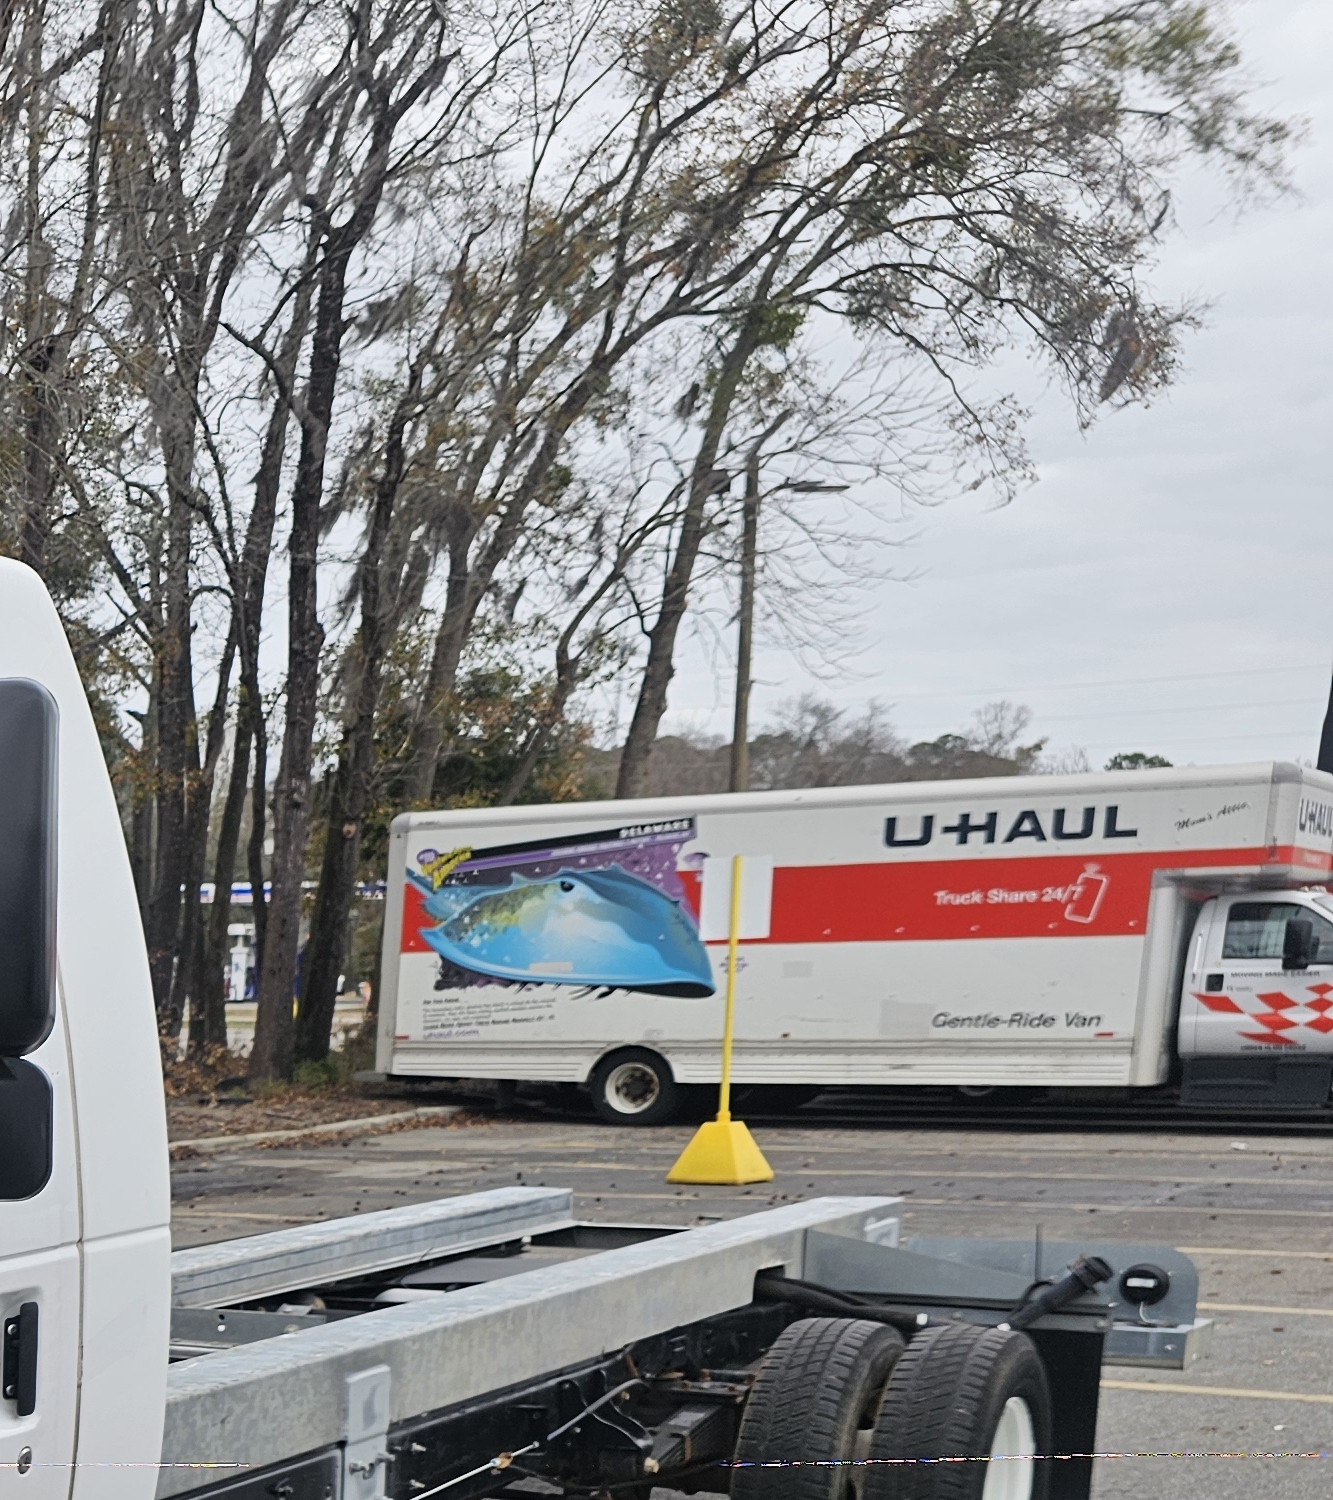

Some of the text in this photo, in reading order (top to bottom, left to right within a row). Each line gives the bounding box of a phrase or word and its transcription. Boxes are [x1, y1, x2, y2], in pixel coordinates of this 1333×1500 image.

[619, 818, 691, 839] DELAWARE
[884, 805, 1139, 848] U-HAUL
[934, 883, 1086, 906] Truck Share 24/7
[932, 1011, 1103, 1029] Gentle-Ride Van
